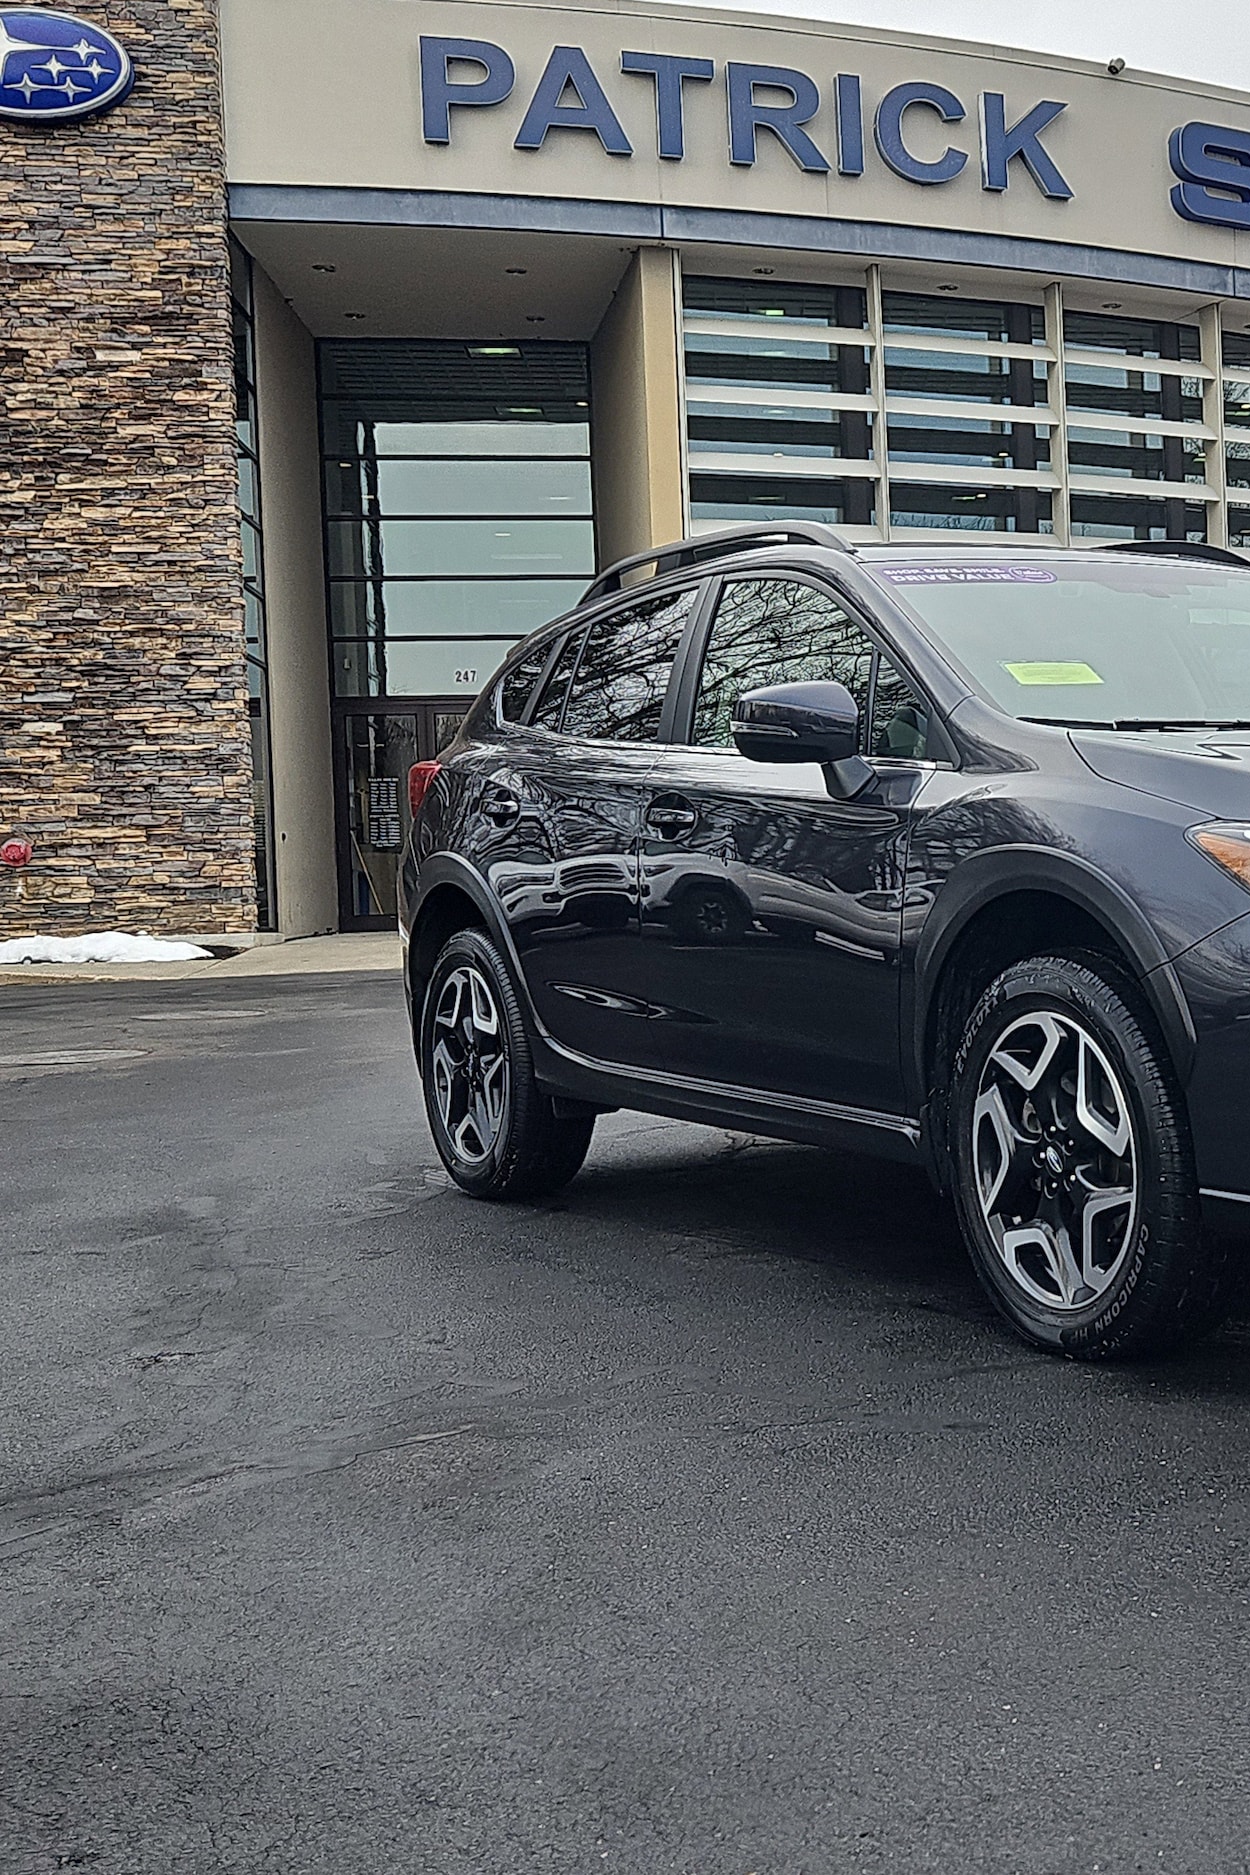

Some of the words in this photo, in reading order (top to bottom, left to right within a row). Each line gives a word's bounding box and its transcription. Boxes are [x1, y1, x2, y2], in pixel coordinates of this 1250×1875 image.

[419, 35, 1074, 201] PATRICK
[455, 670, 477, 682] 247
[1094, 1223, 1149, 1334] CAPRICORN
